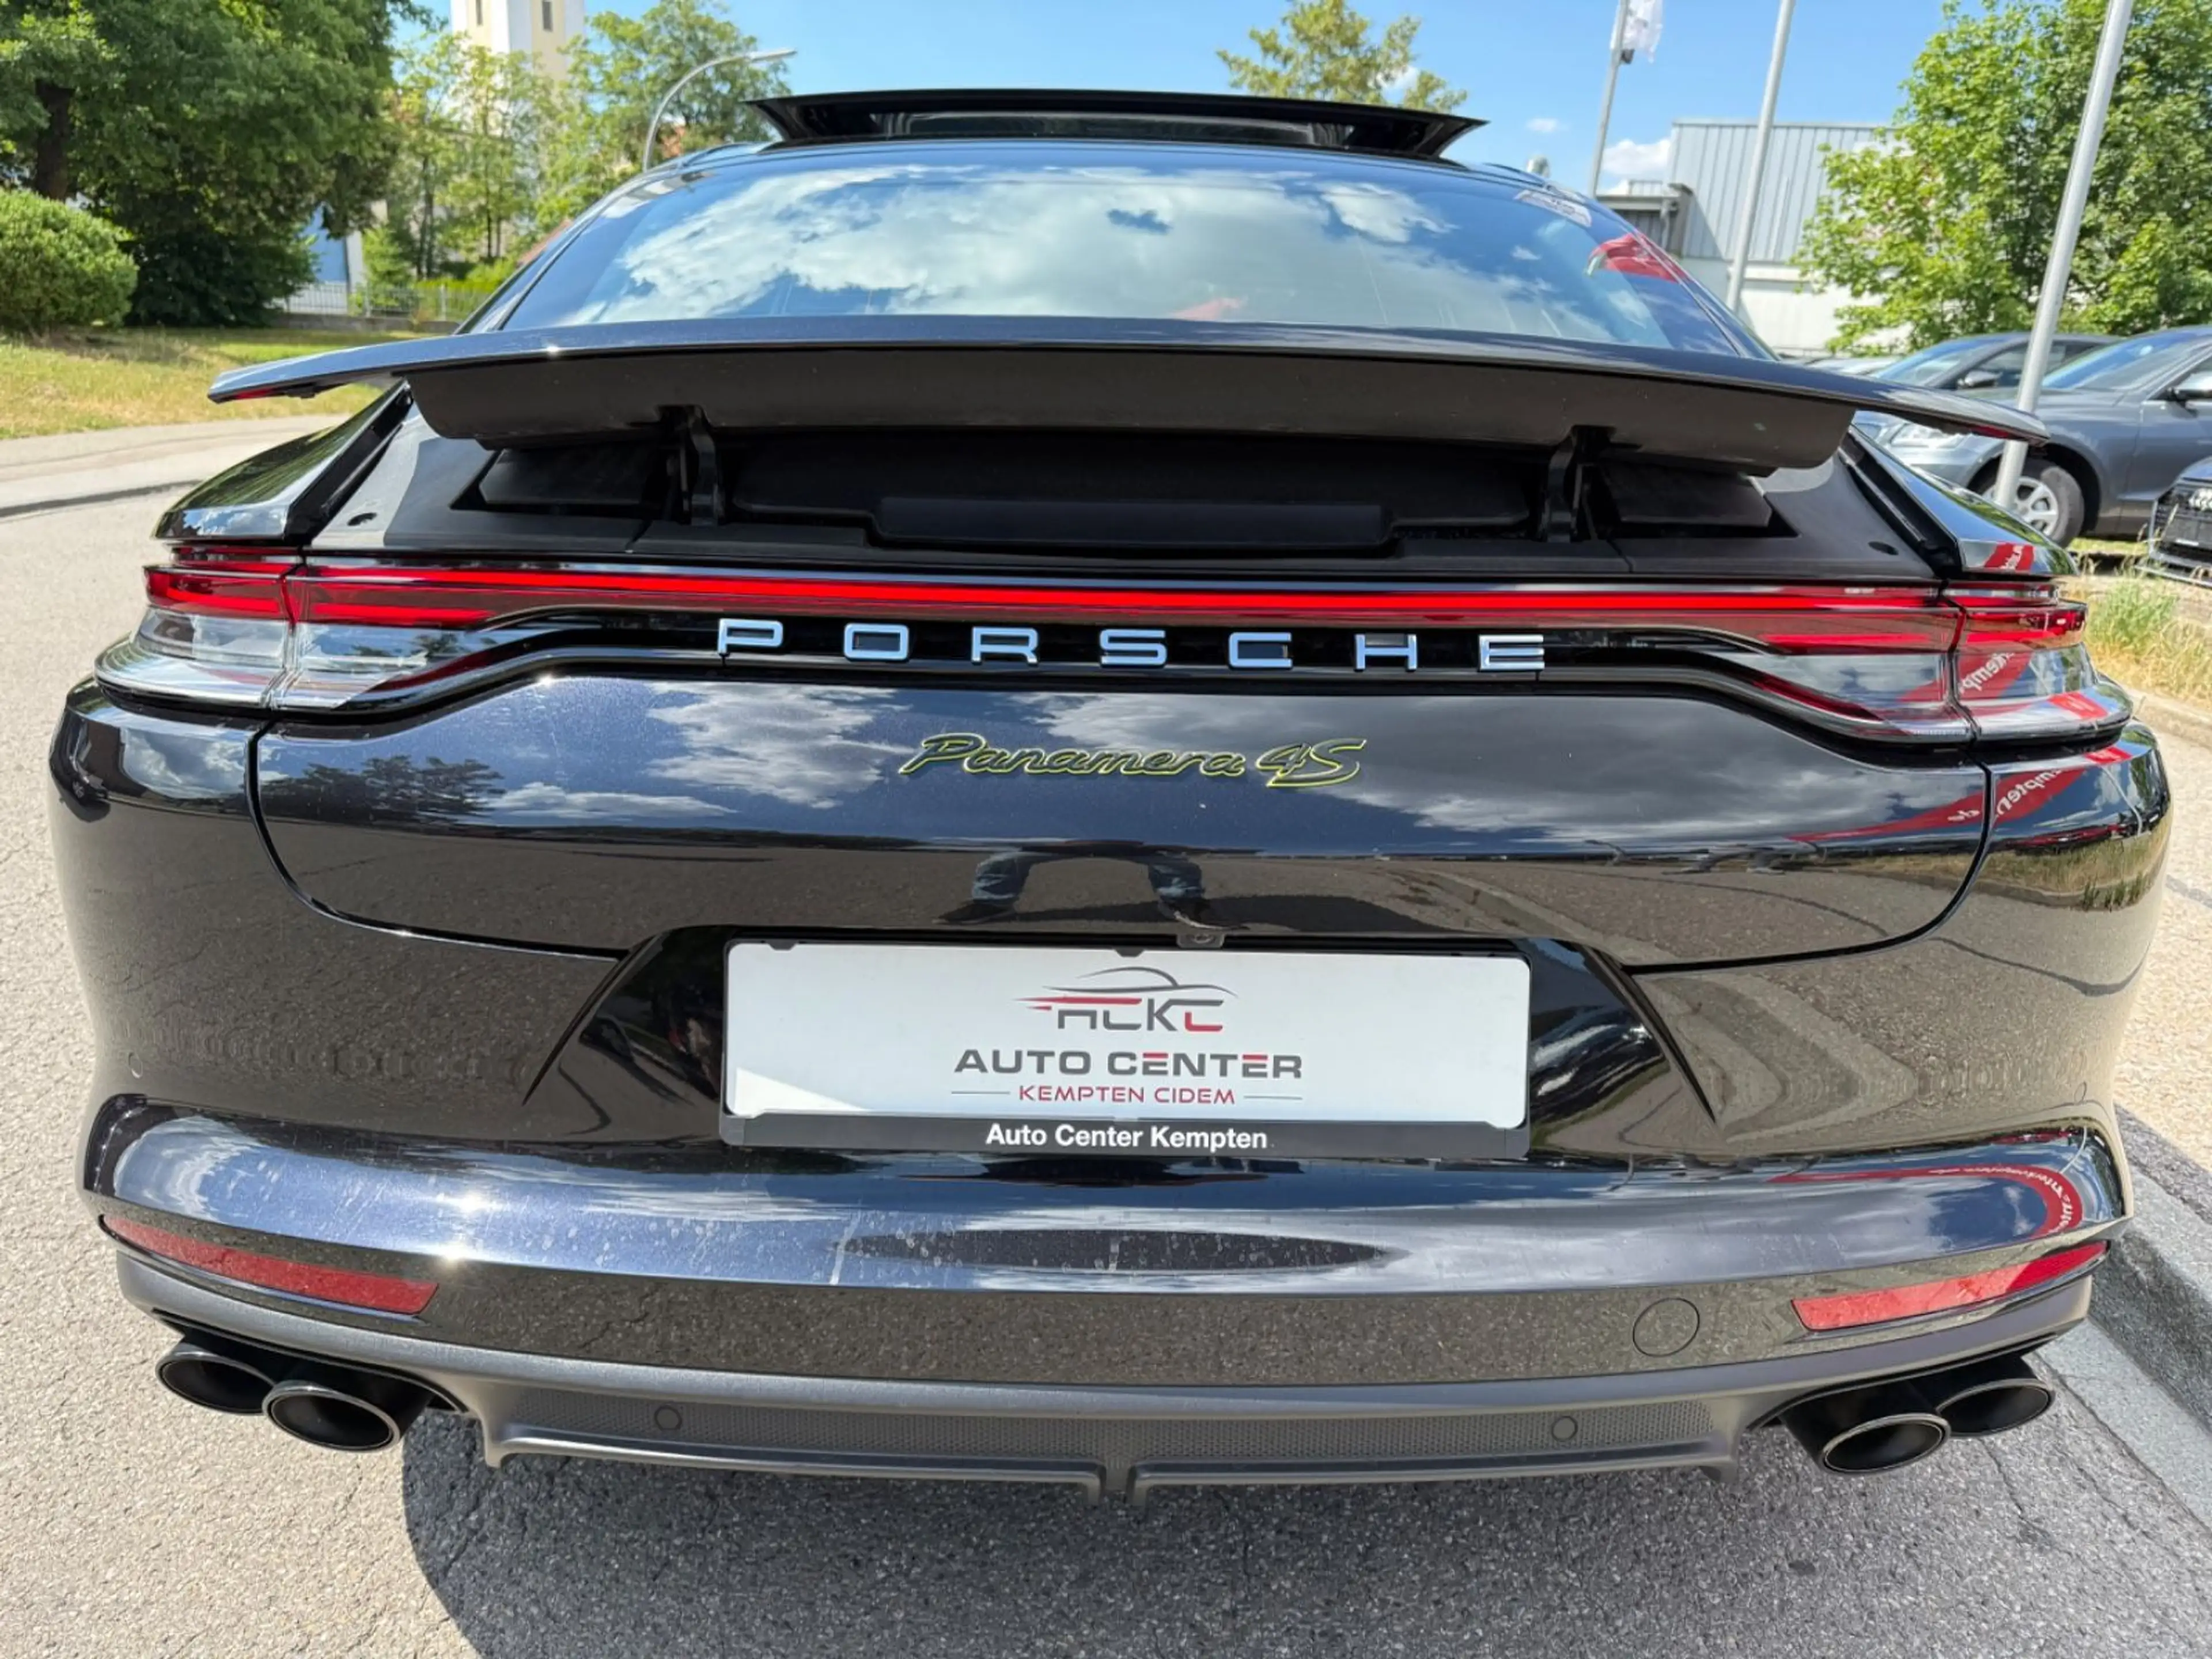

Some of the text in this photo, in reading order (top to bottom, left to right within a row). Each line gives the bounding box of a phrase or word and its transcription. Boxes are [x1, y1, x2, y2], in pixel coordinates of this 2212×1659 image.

[718, 618, 1545, 670] PORSCHE
[899, 733, 1367, 787] Panamera 4S
[954, 1050, 1303, 1078] AUTO CENTER
[1020, 1085, 1235, 1105] KEMPTEN CIDEM
[986, 1124, 1268, 1152] Auto Center Kempten
